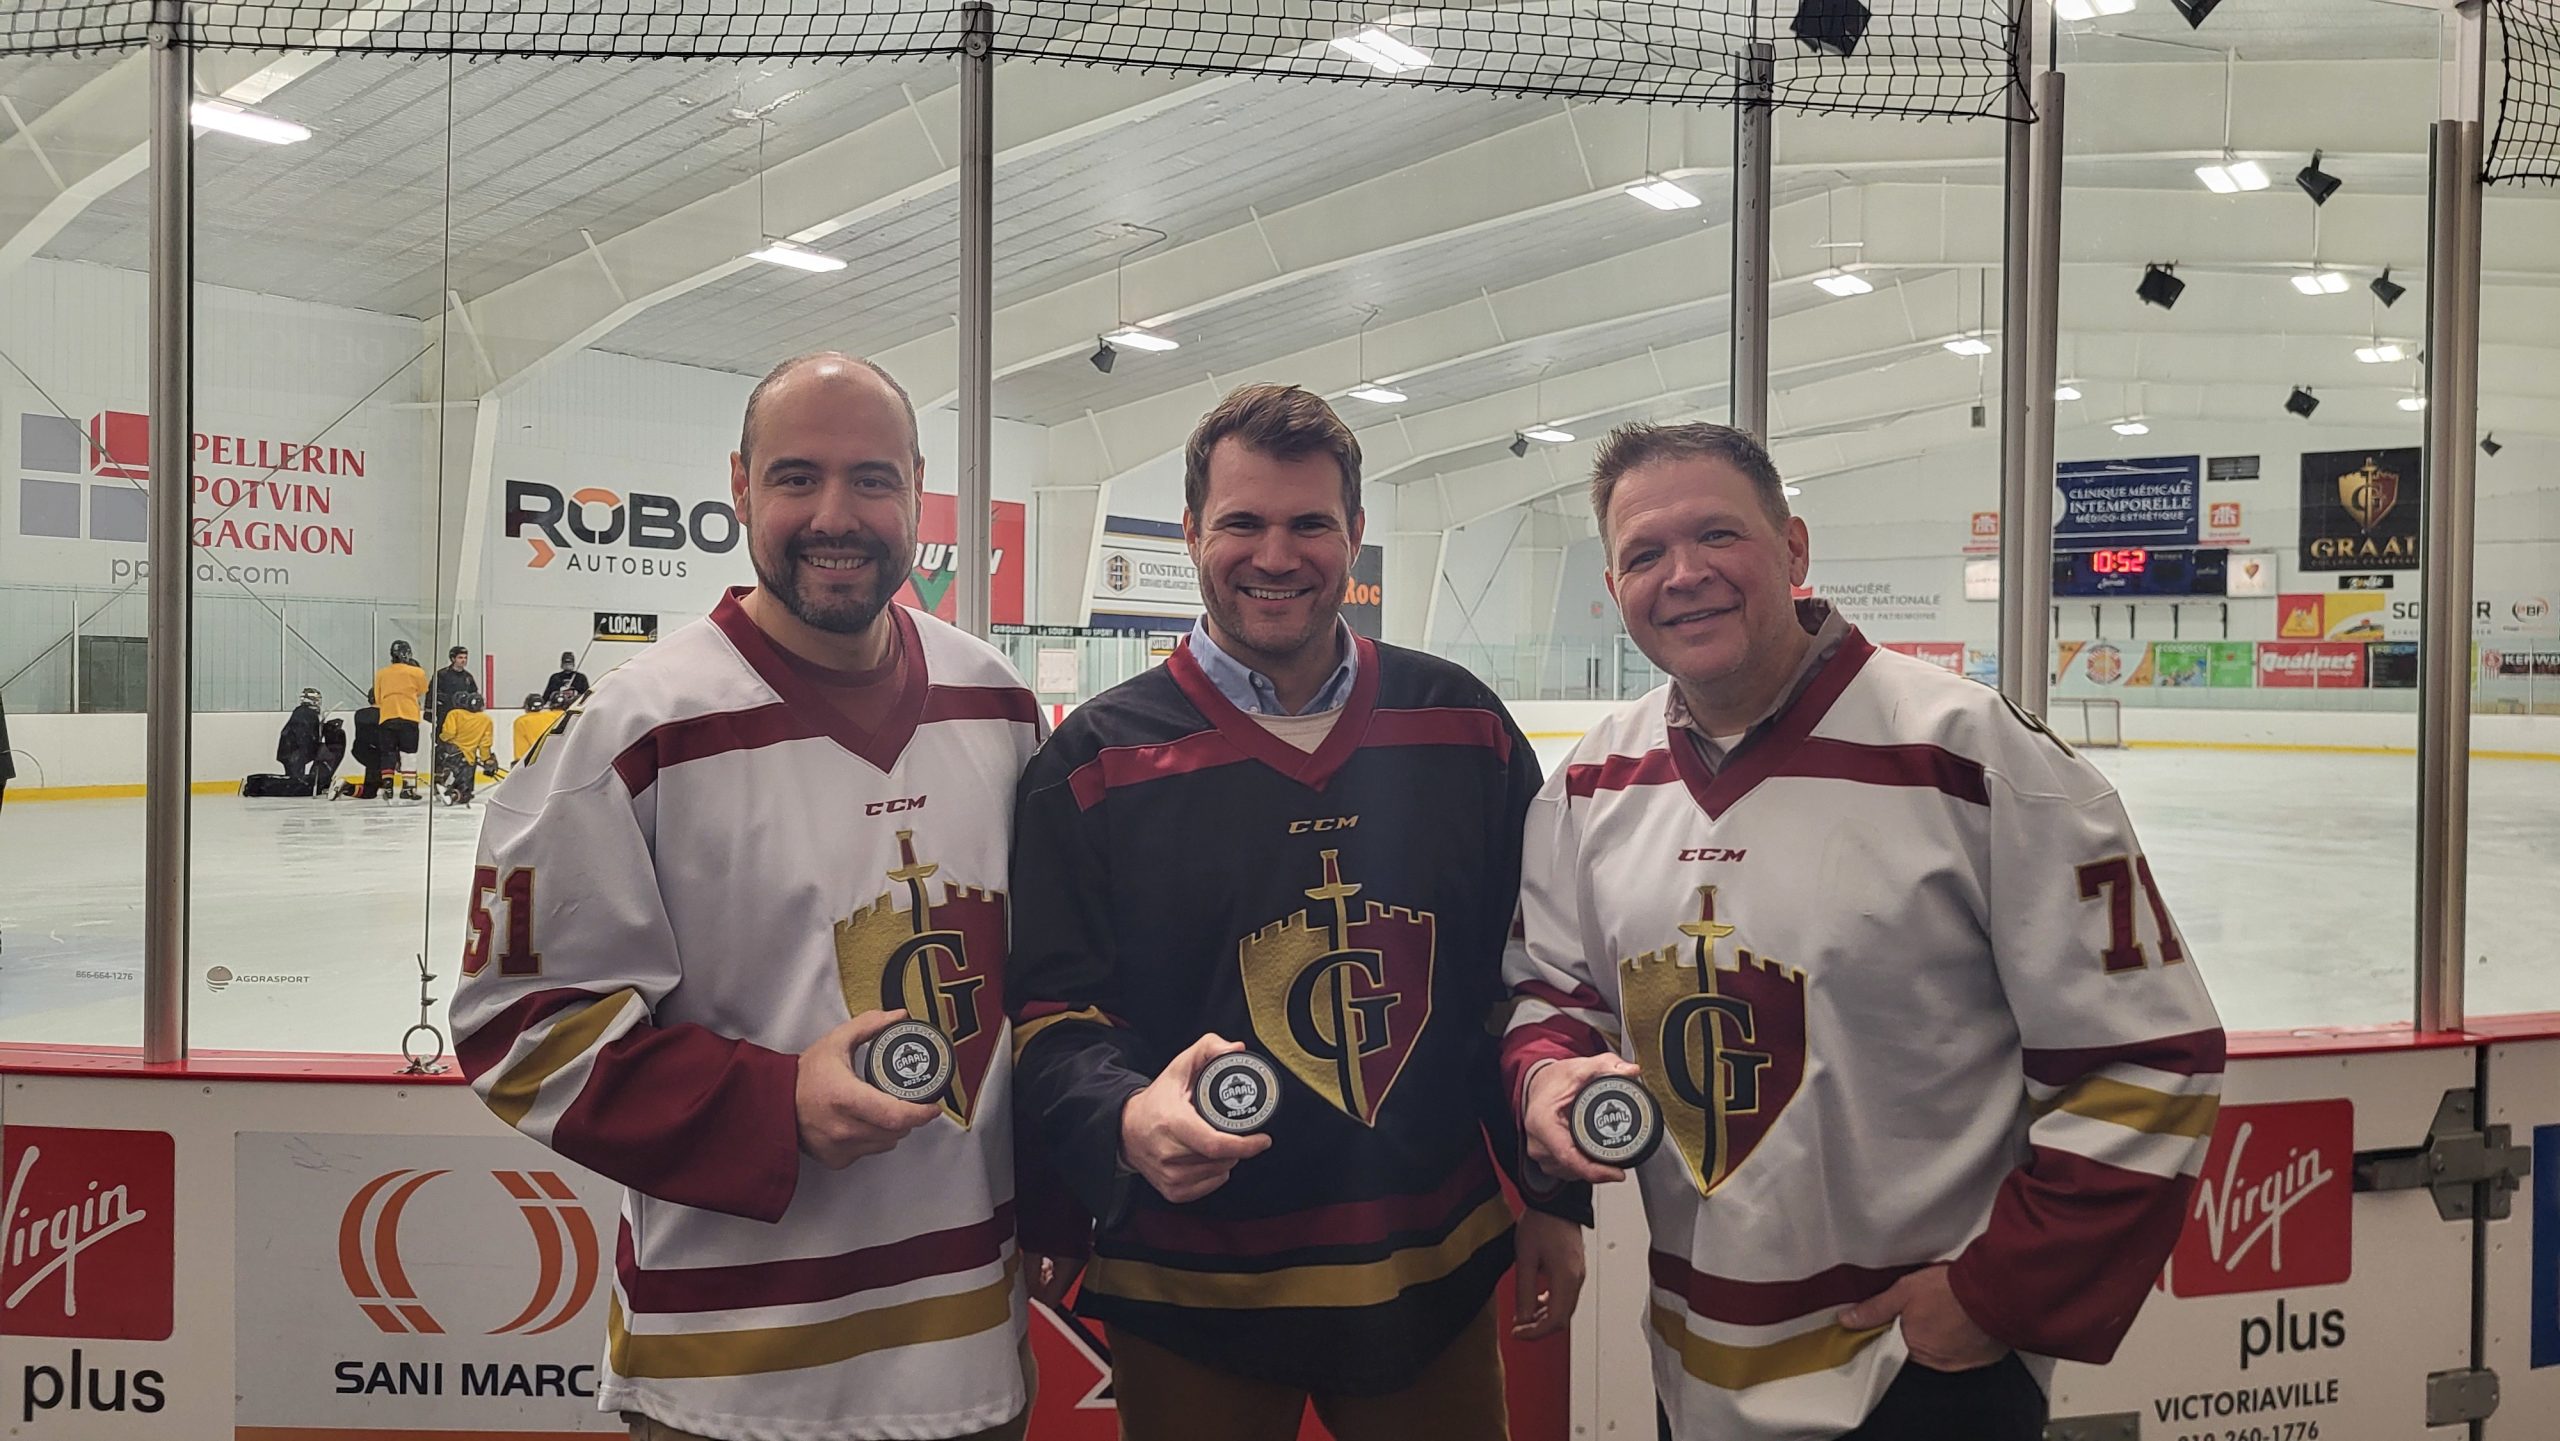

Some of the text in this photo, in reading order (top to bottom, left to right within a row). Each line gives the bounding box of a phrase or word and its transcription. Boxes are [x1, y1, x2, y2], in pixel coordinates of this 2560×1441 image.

[192, 433, 366, 477] PELLERIN
[192, 475, 331, 514] POTVIN
[2069, 483, 2192, 500] CLINIQUE MÉDICALE
[2069, 497, 2192, 513] INTEMPORELLE
[192, 517, 354, 556] GAGNON
[111, 557, 290, 585] ppa.com
[566, 553, 687, 578] AUTOBUS
[2092, 549, 2146, 573] 10:52
[1819, 582, 1891, 594] FINANCIÈRE
[1832, 595, 1941, 606] ANQUE NATIONALE
[608, 616, 644, 634] LOCAL
[864, 795, 927, 817] CCM
[1288, 815, 1359, 835] CCM
[1678, 848, 1747, 863] CCM
[463, 865, 542, 978] 51
[2074, 853, 2185, 976] 71
[235, 974, 311, 985] AGORASPORT
[895, 1052, 929, 1071] GRAAL
[1222, 1085, 1256, 1101] GRAAL
[1597, 1111, 1630, 1128] GRAAL
[2194, 1121, 2333, 1272] Virgin
[2240, 1298, 2346, 1370] plus
[23, 1348, 166, 1422] plus
[334, 1361, 596, 1398] SANI MARC
[2154, 1378, 2339, 1423] VICTORIAVILLE
